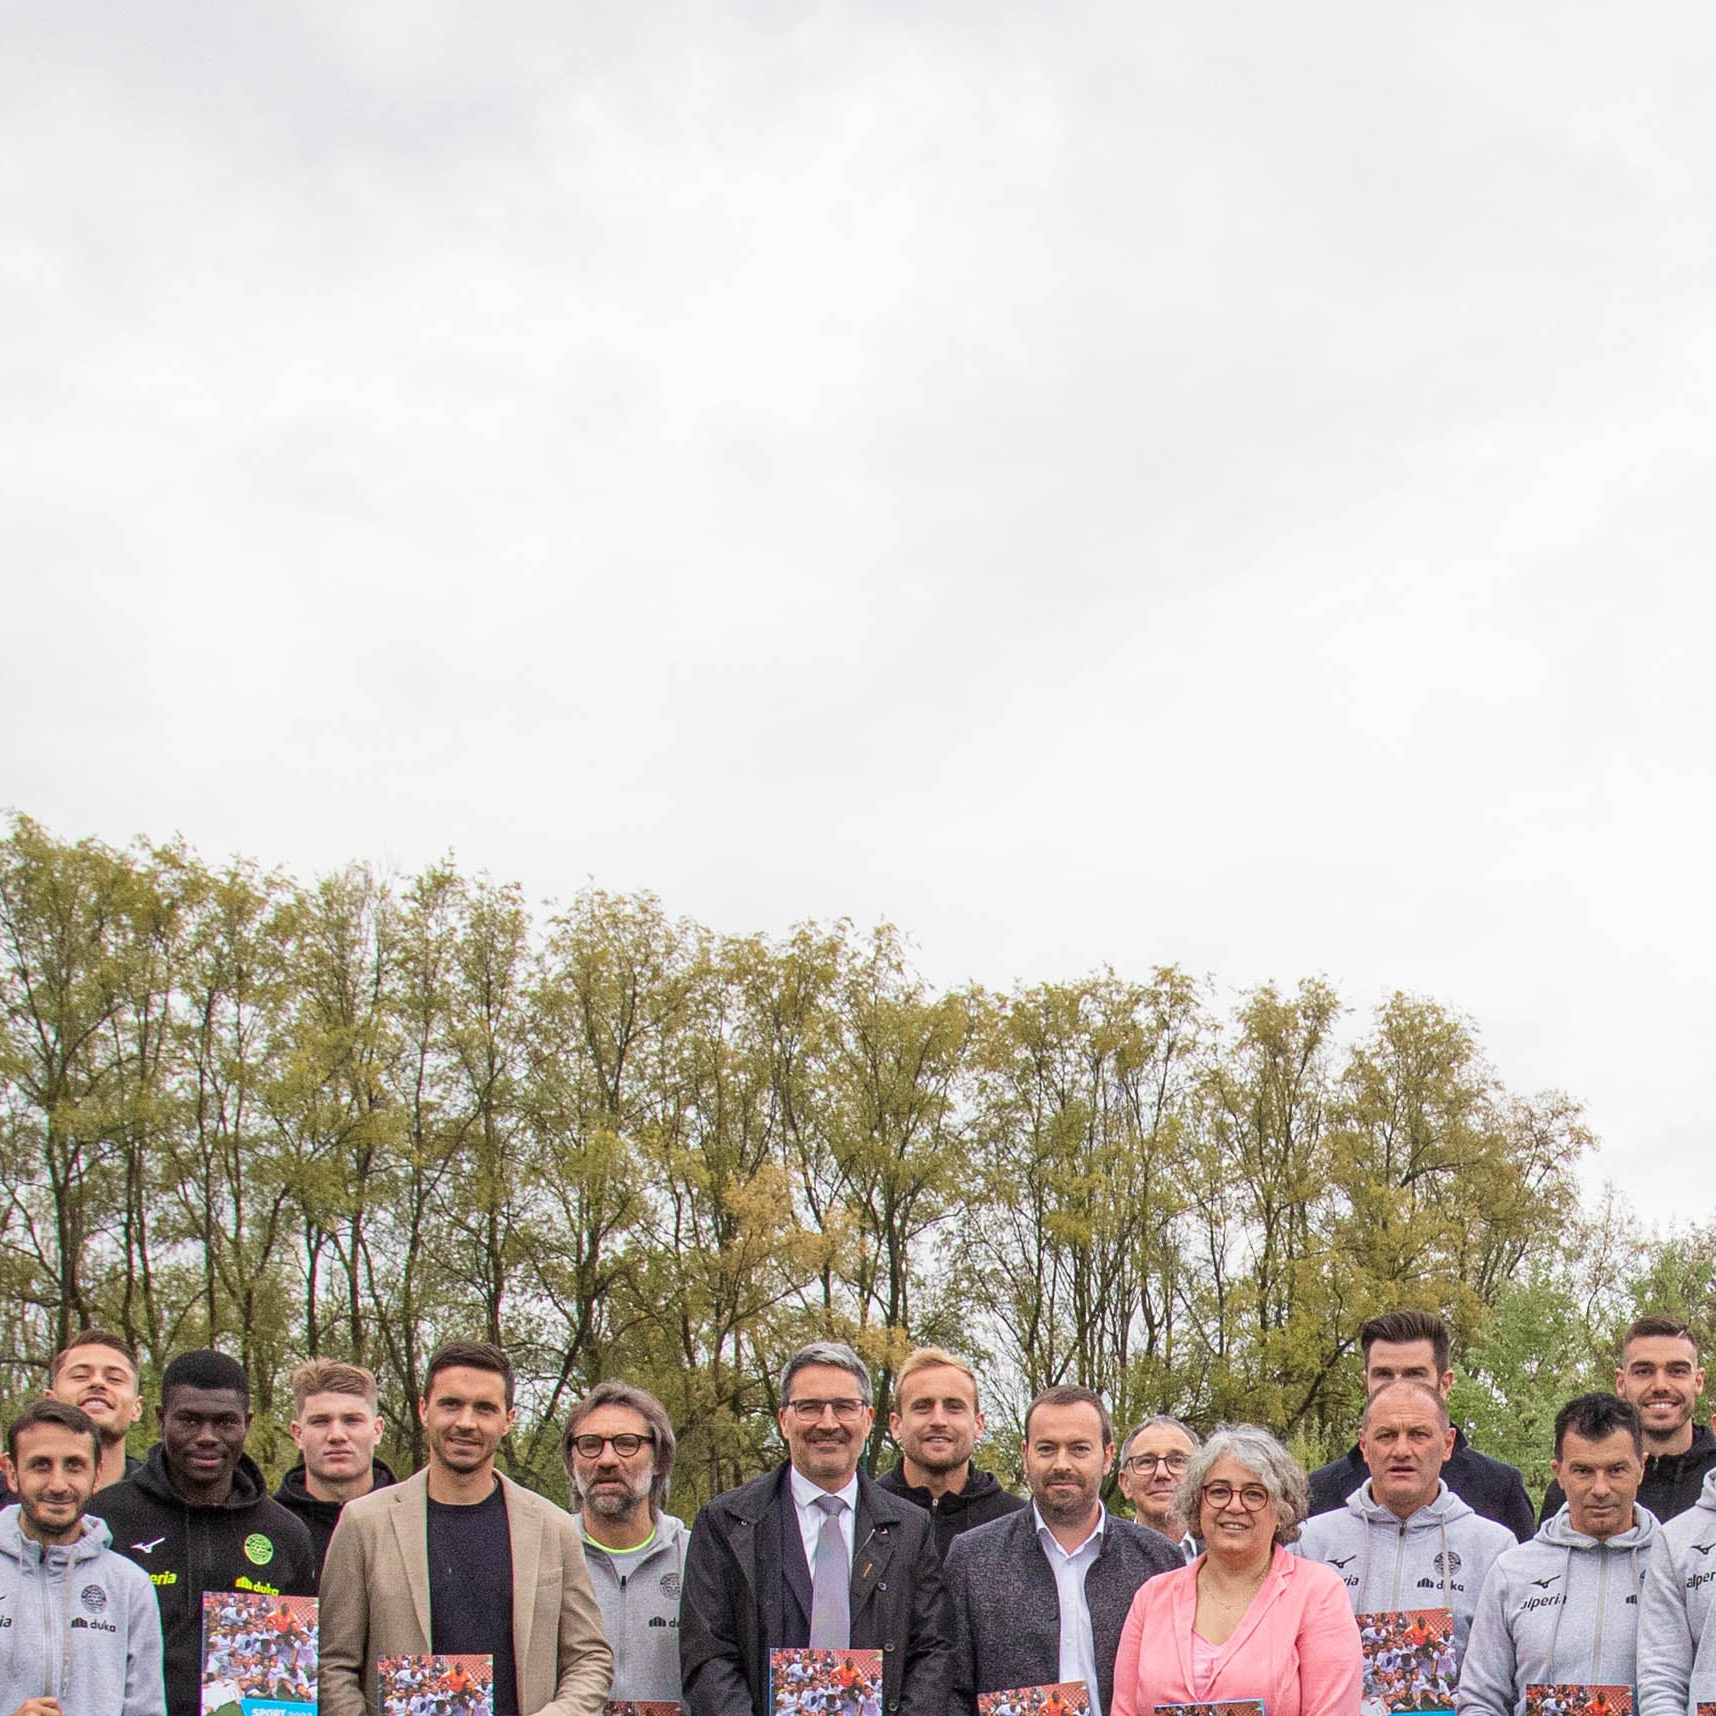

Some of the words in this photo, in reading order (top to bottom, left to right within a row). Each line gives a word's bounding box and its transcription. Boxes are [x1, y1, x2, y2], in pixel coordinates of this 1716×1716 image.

[149, 1571, 178, 1586] eria
[253, 1581, 280, 1597] duka
[1436, 1580, 1465, 1593] dka
[90, 1619, 117, 1633] duka
